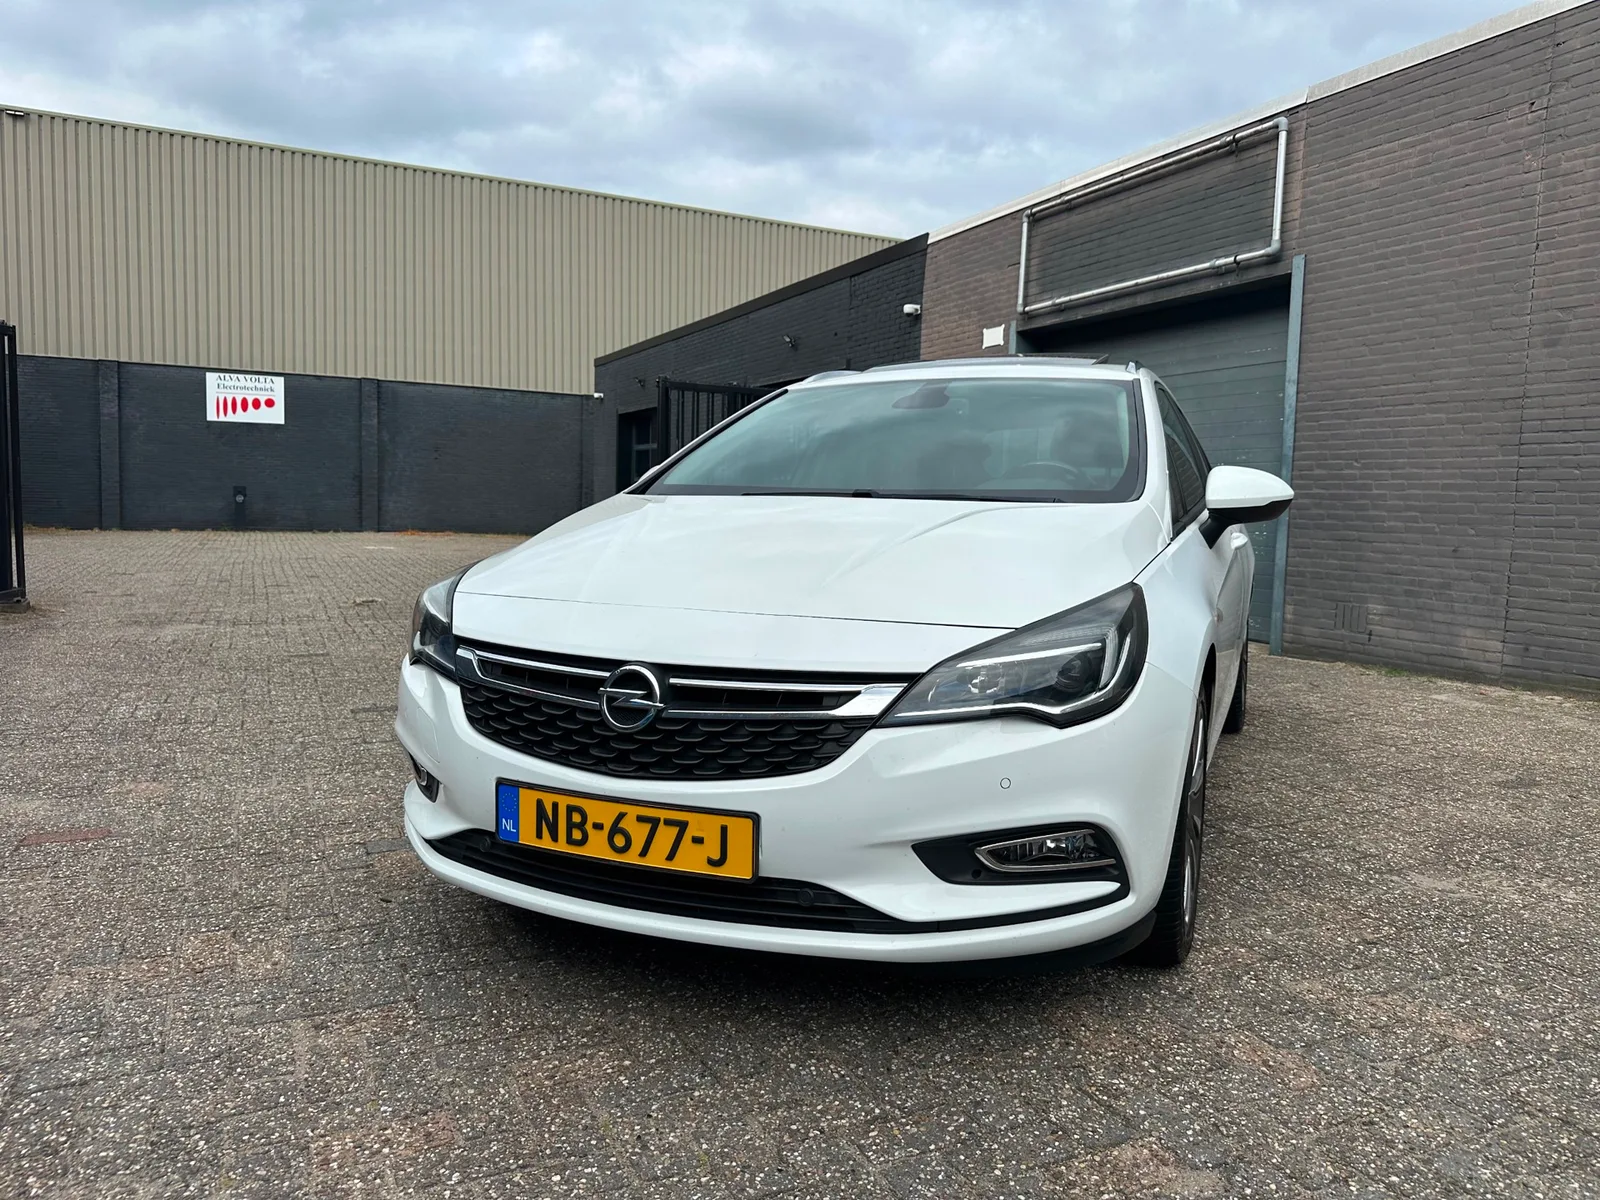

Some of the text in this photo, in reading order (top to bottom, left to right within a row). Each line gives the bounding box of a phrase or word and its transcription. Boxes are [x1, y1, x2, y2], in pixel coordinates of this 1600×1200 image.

[216, 374, 275, 385] ALVA VOLTA
[217, 383, 275, 393] Electrotechniek
[502, 818, 517, 832] NL
[535, 798, 728, 867] NB-677-J
